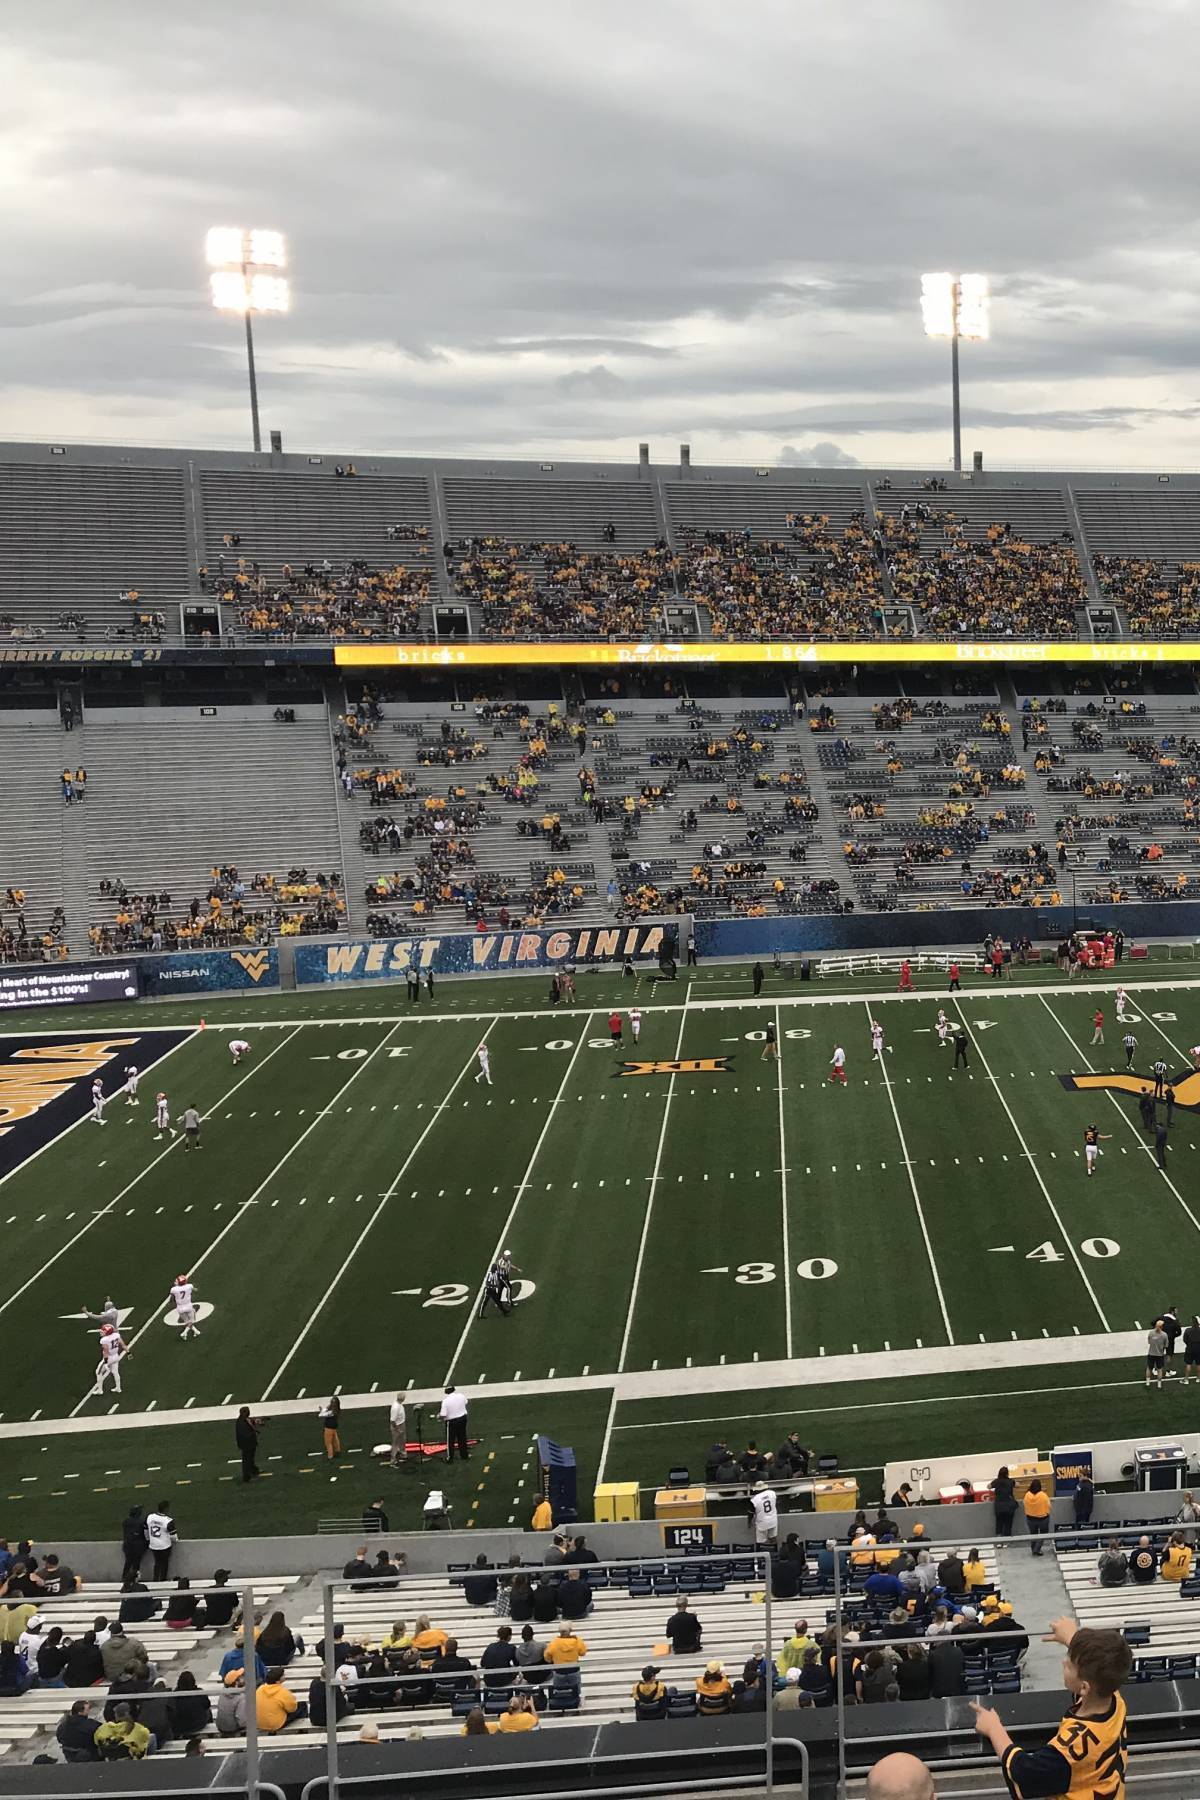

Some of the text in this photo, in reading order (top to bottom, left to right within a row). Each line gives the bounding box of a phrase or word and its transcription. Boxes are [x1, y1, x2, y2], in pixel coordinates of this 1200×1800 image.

[60, 650, 133, 661] RODGERS
[143, 649, 162, 661] 21
[327, 927, 665, 974] WEST VIRGINIA
[3, 969, 130, 987] Heart of Mountaineer Country!
[159, 968, 210, 979] NISSAN
[17, 989, 28, 998] in
[29, 987, 49, 997] the
[763, 1500, 772, 1513] 8
[673, 1528, 704, 1545] 124
[45, 1583, 60, 1593] 79
[906, 1599, 917, 1616] 5
